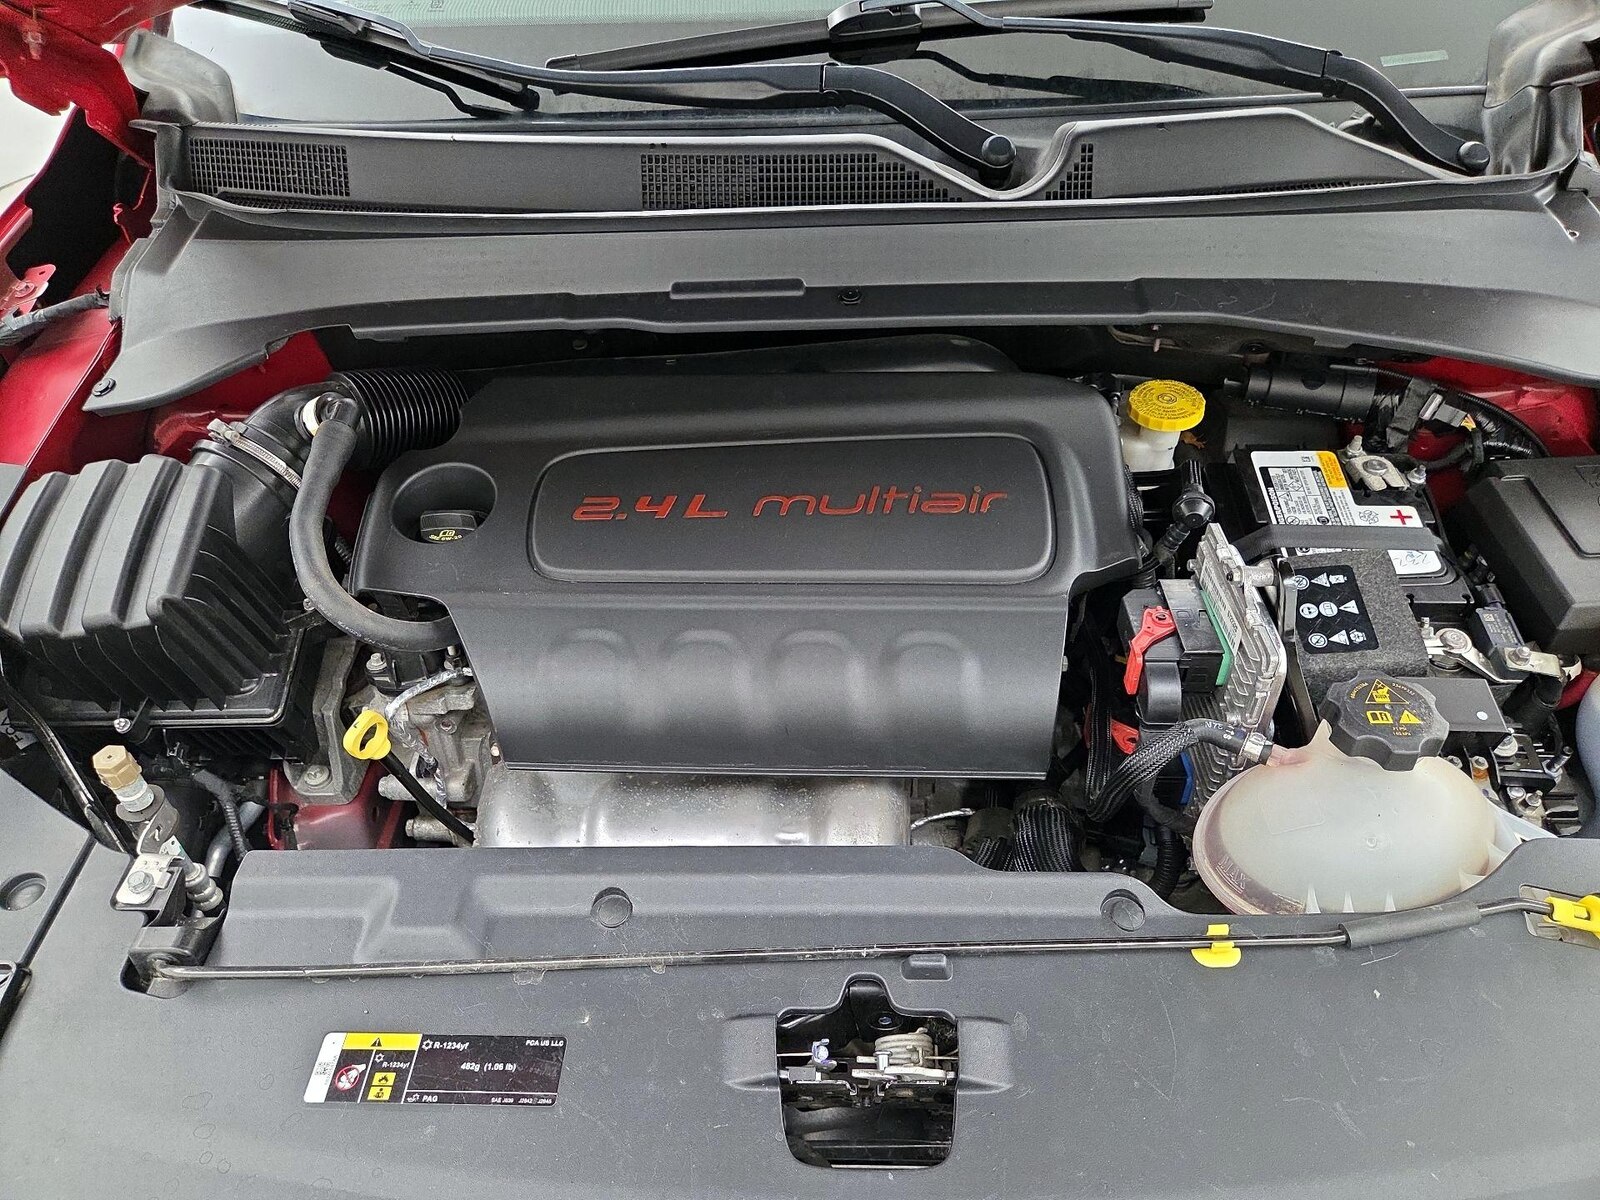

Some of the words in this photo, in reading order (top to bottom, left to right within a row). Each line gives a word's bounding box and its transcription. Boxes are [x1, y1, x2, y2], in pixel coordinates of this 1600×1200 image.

[571, 494, 729, 521] 2.4L
[751, 485, 1008, 517] multiair
[1217, 855, 1246, 889] MAX
[433, 1041, 470, 1051] R-1234yf
[540, 1039, 550, 1047] US
[382, 1061, 410, 1069] R-1234yf
[460, 1062, 480, 1072] 482g
